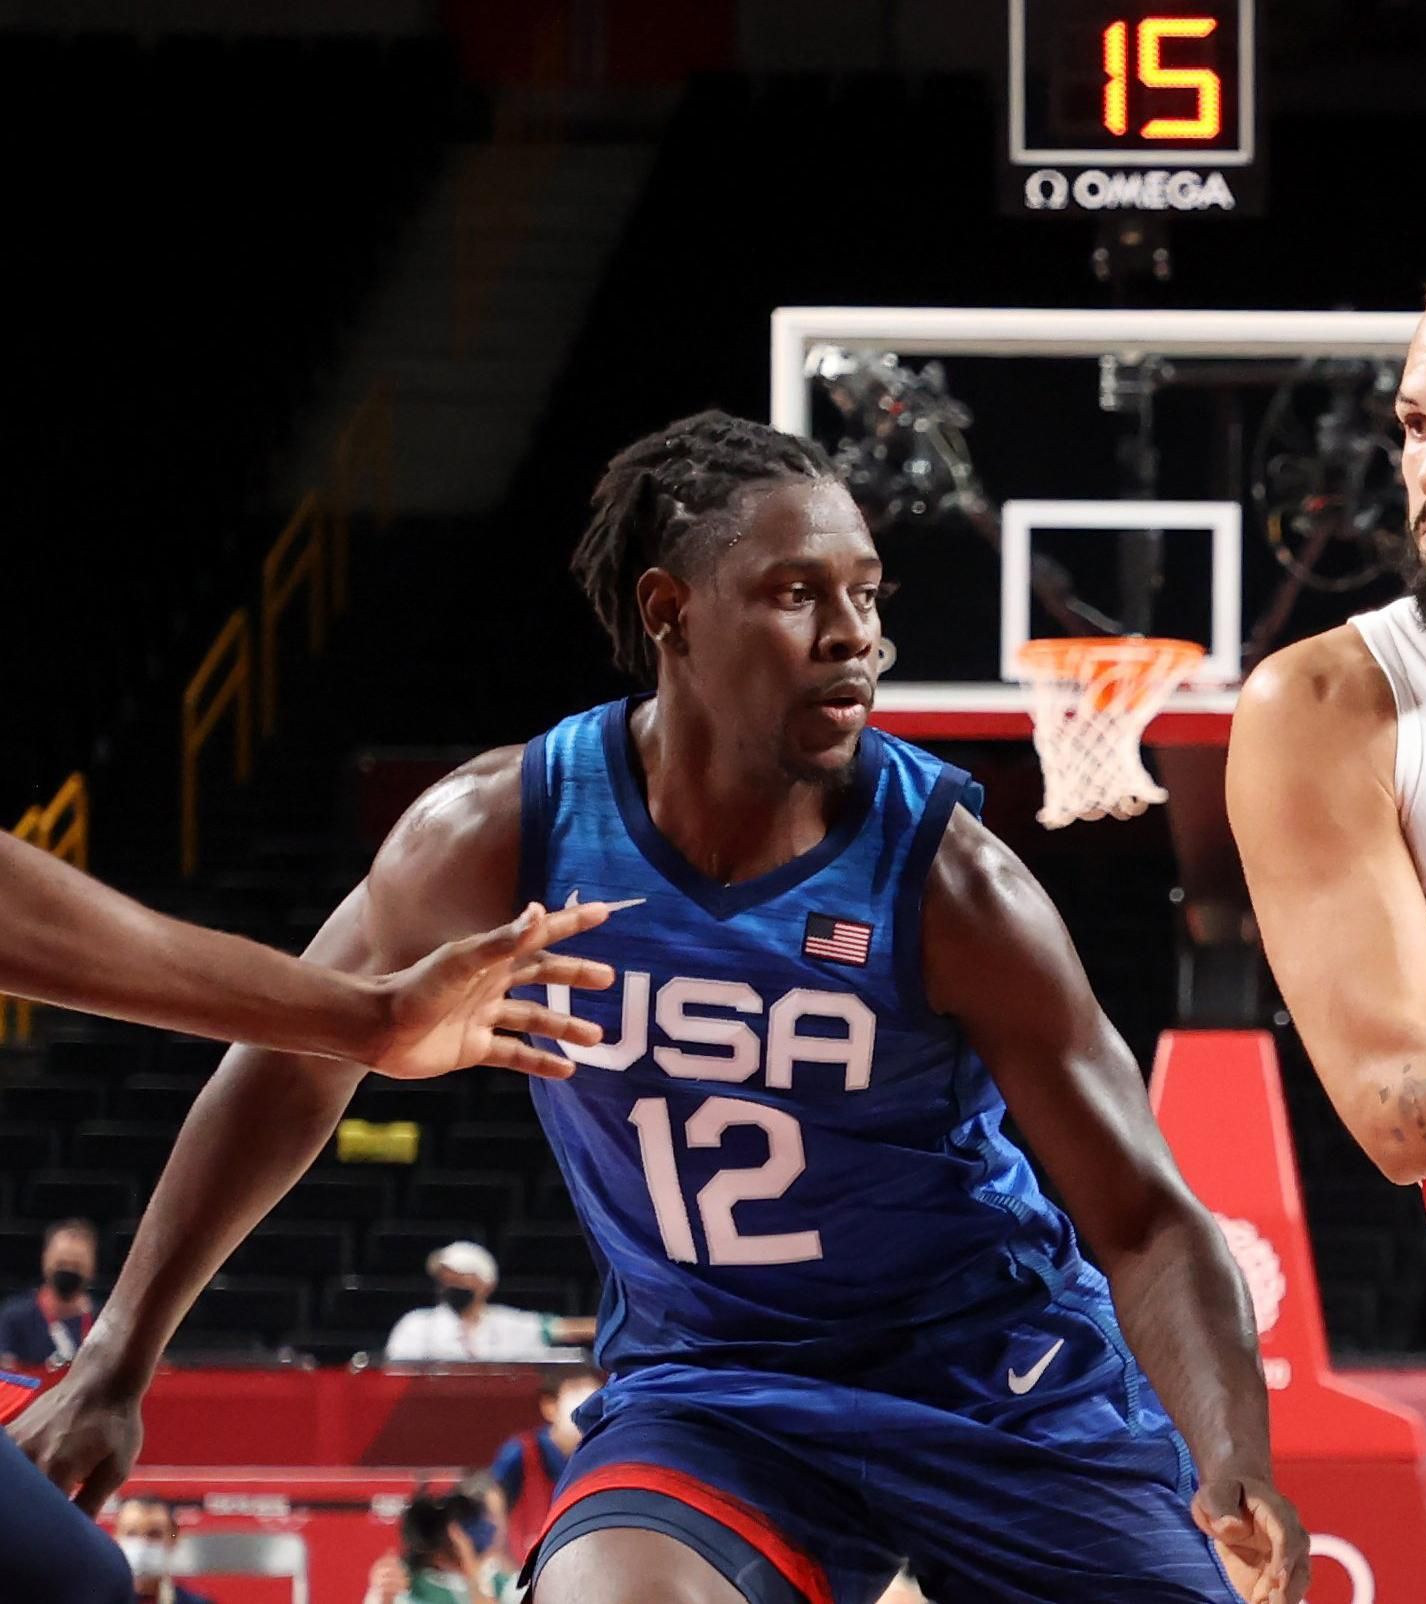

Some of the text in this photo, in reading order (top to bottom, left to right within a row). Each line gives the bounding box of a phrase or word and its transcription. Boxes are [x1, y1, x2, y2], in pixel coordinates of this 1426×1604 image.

[1103, 18, 1220, 139] 15
[1073, 170, 1236, 210] OMEGA
[547, 971, 877, 1091] USA
[627, 1096, 824, 1266] 12
